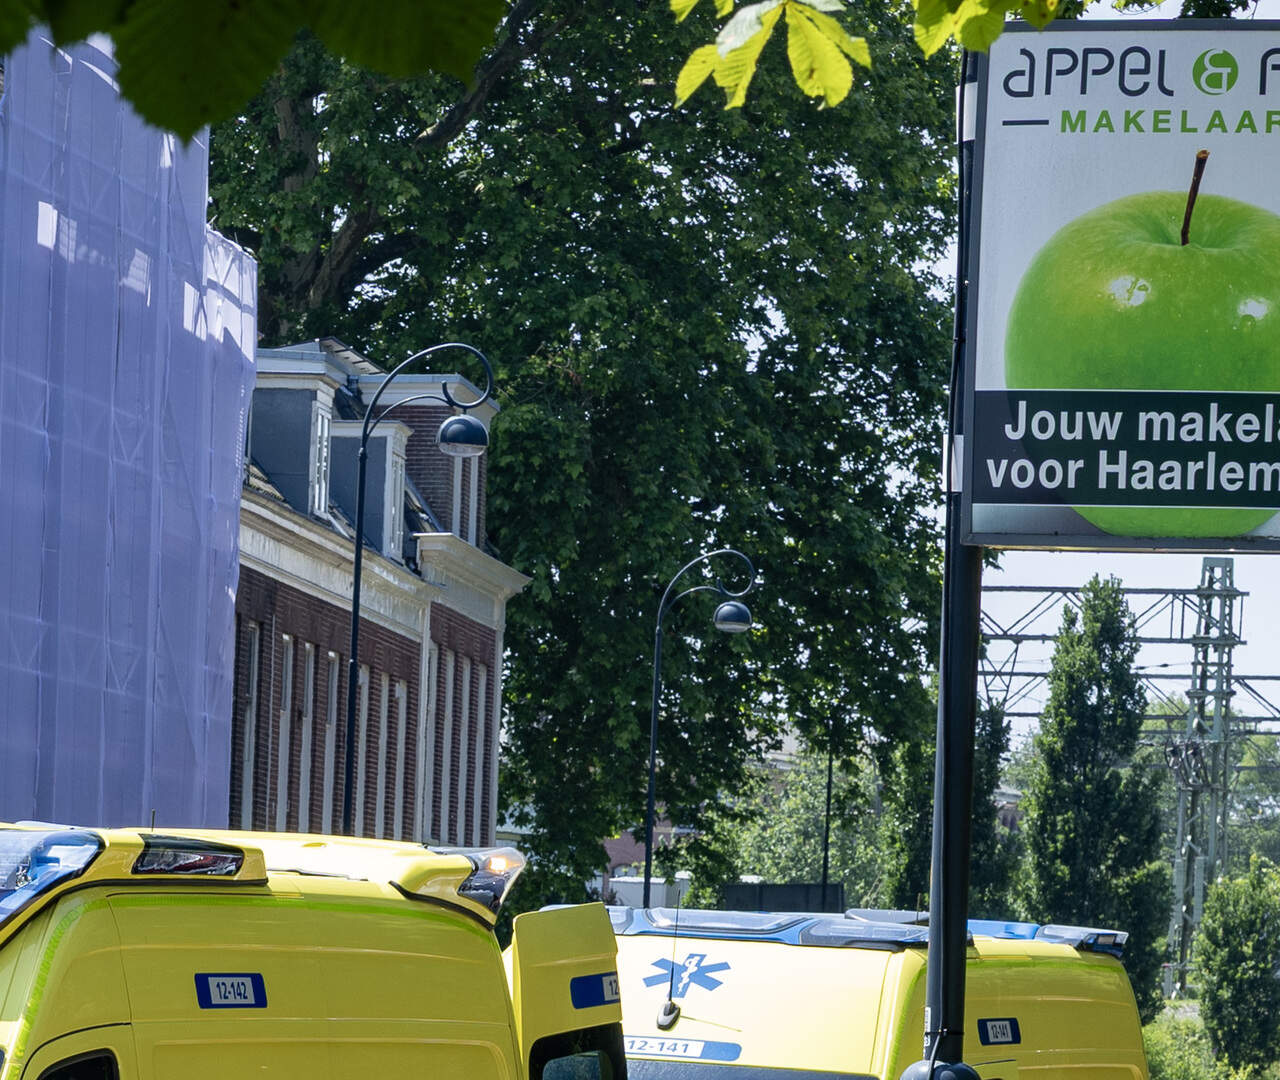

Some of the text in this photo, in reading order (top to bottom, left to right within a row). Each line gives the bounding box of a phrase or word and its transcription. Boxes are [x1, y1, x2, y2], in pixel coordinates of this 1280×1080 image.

[1005, 400, 1123, 441] Jouw
[987, 458, 1084, 489] voor
[215, 981, 249, 1000] 12-142
[989, 1021, 1010, 1040] 12-141
[627, 1040, 690, 1053] 12-141
